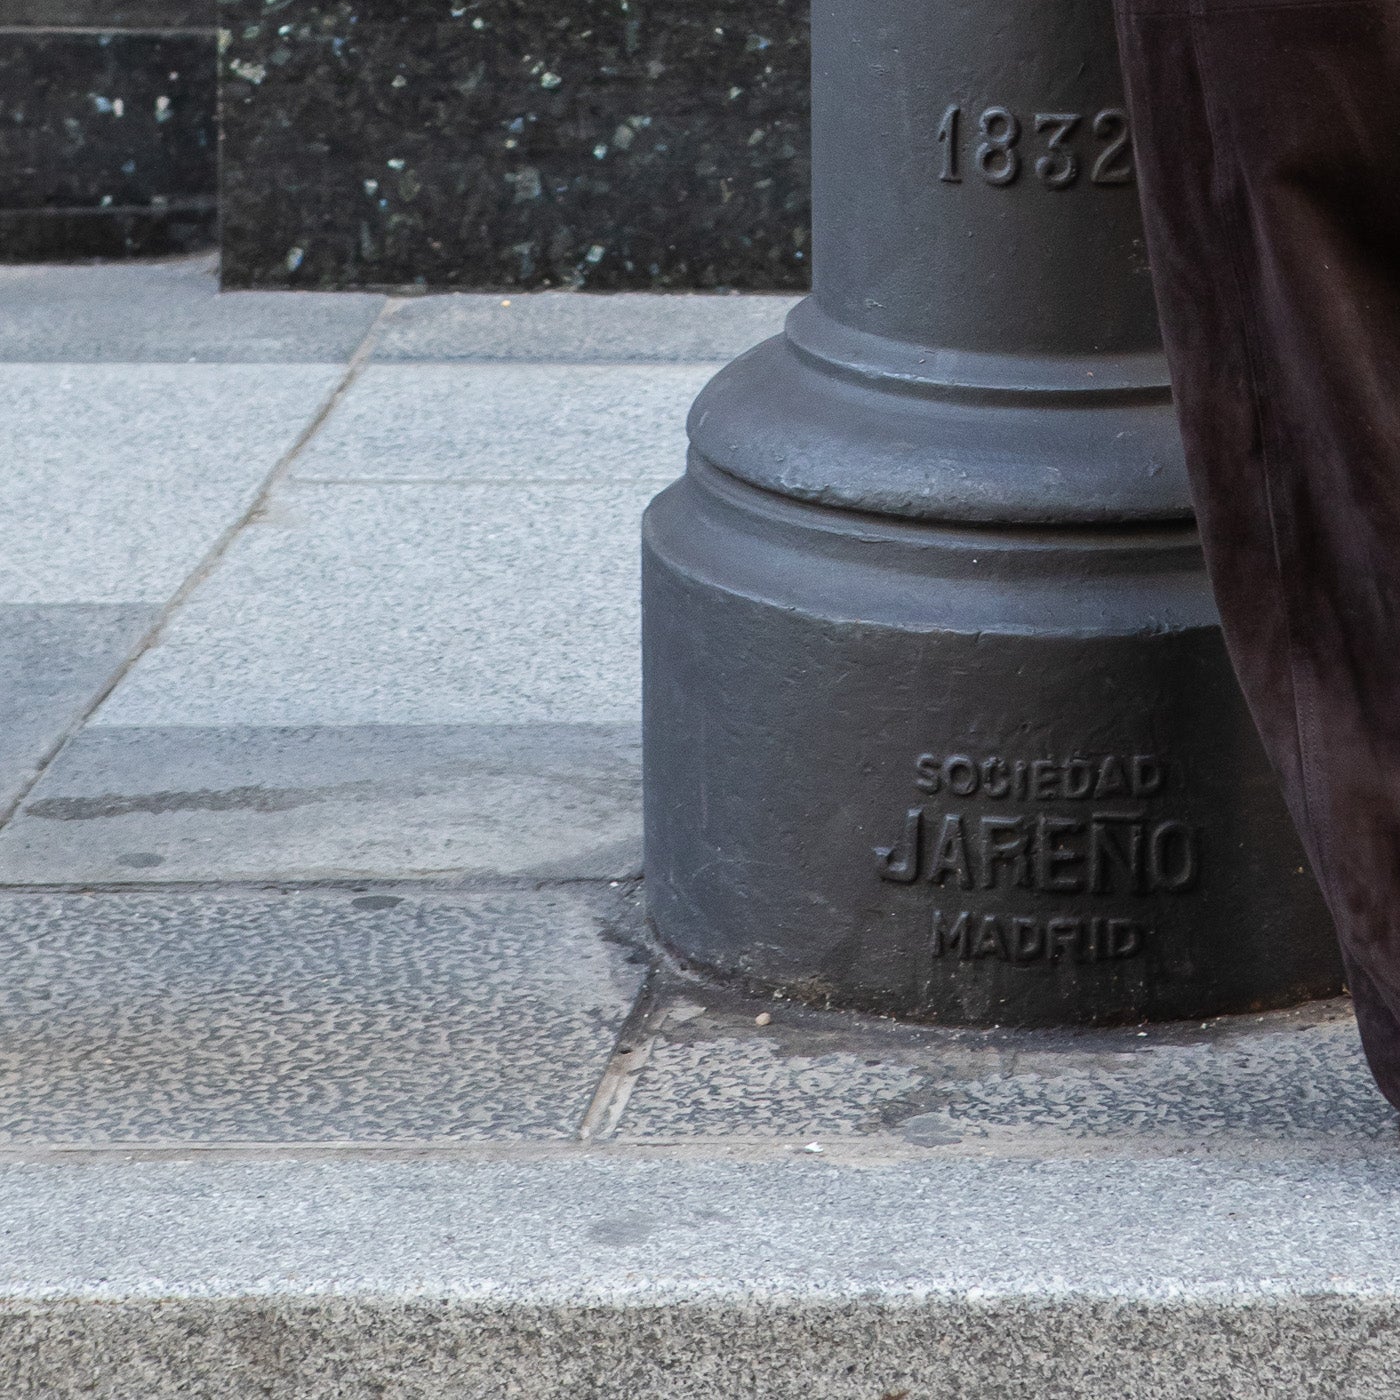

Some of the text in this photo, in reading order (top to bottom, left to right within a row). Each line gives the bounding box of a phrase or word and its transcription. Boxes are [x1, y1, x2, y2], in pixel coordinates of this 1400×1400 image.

[938, 103, 1136, 187] 1832
[915, 752, 1163, 800] SOCIEDAD
[931, 910, 1145, 961] MADRID
